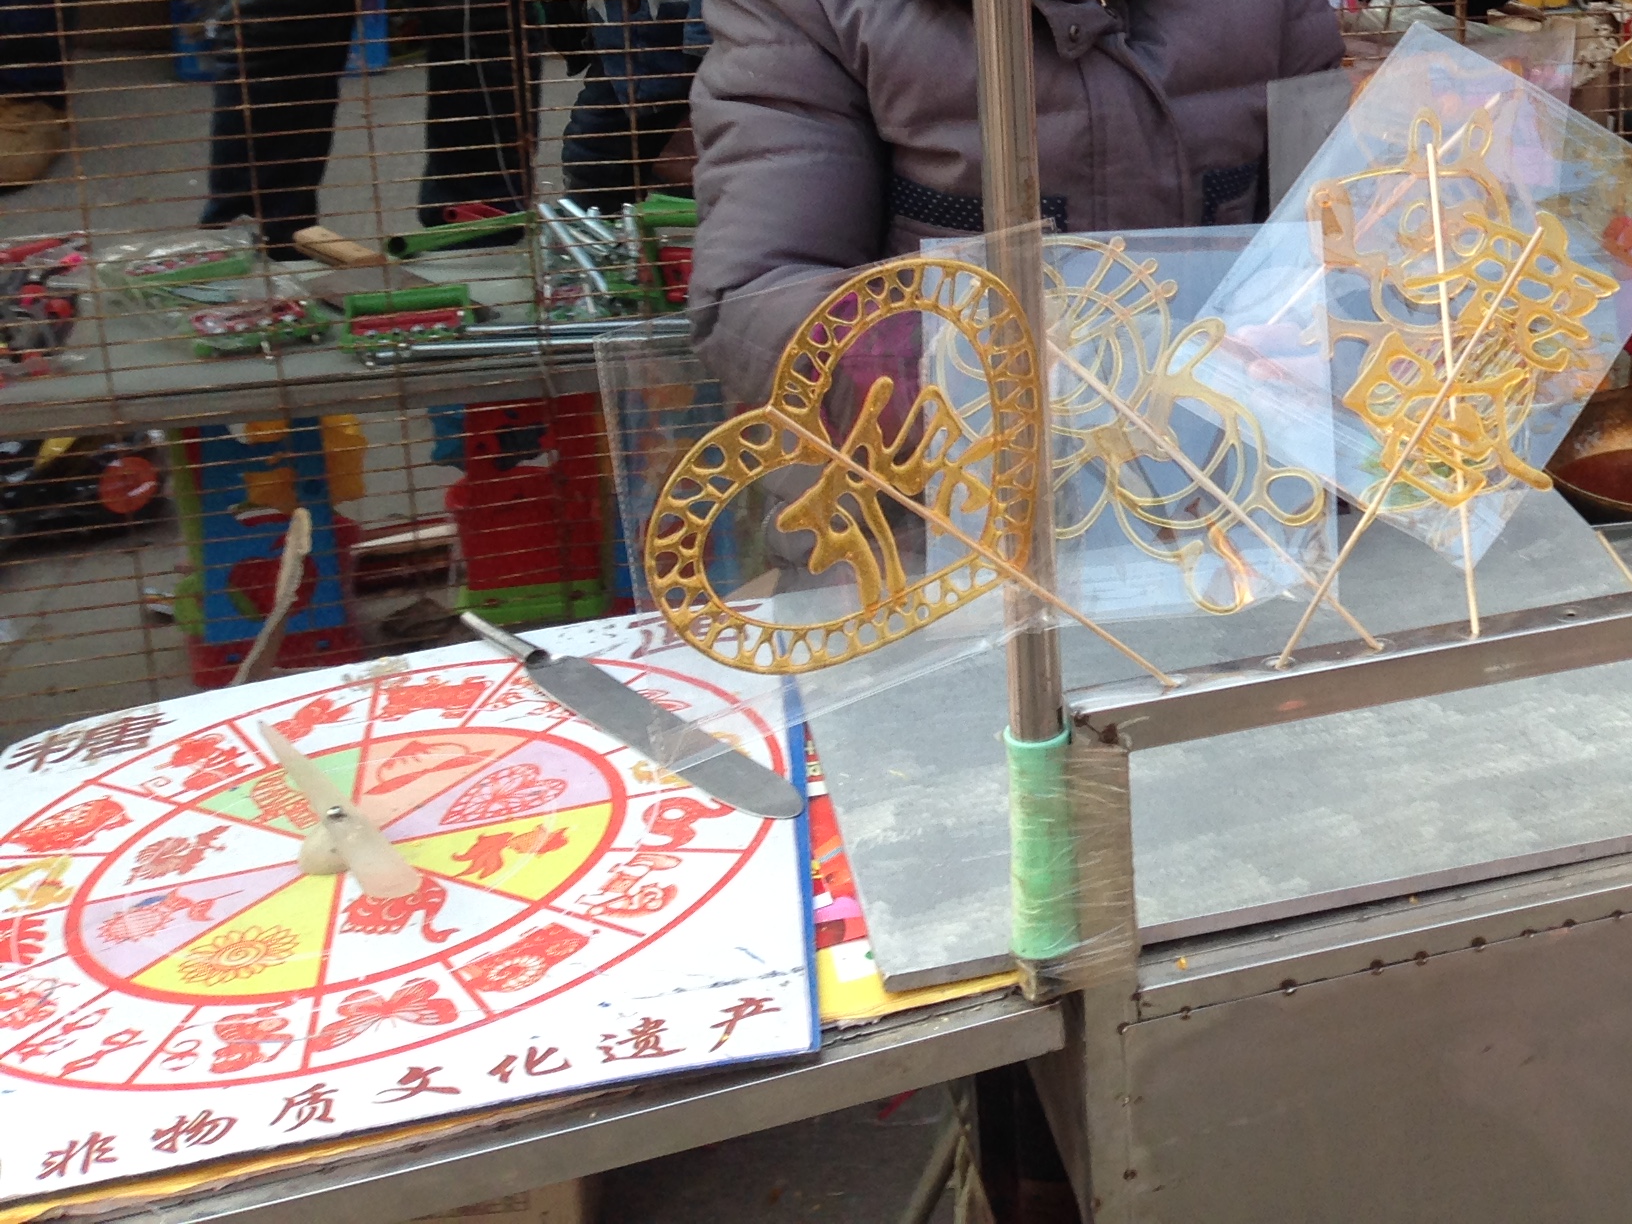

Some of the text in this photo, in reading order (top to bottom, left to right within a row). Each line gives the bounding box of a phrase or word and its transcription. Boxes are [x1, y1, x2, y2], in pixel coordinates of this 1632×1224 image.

[36, 997, 781, 1180] 非物质文化遗产
